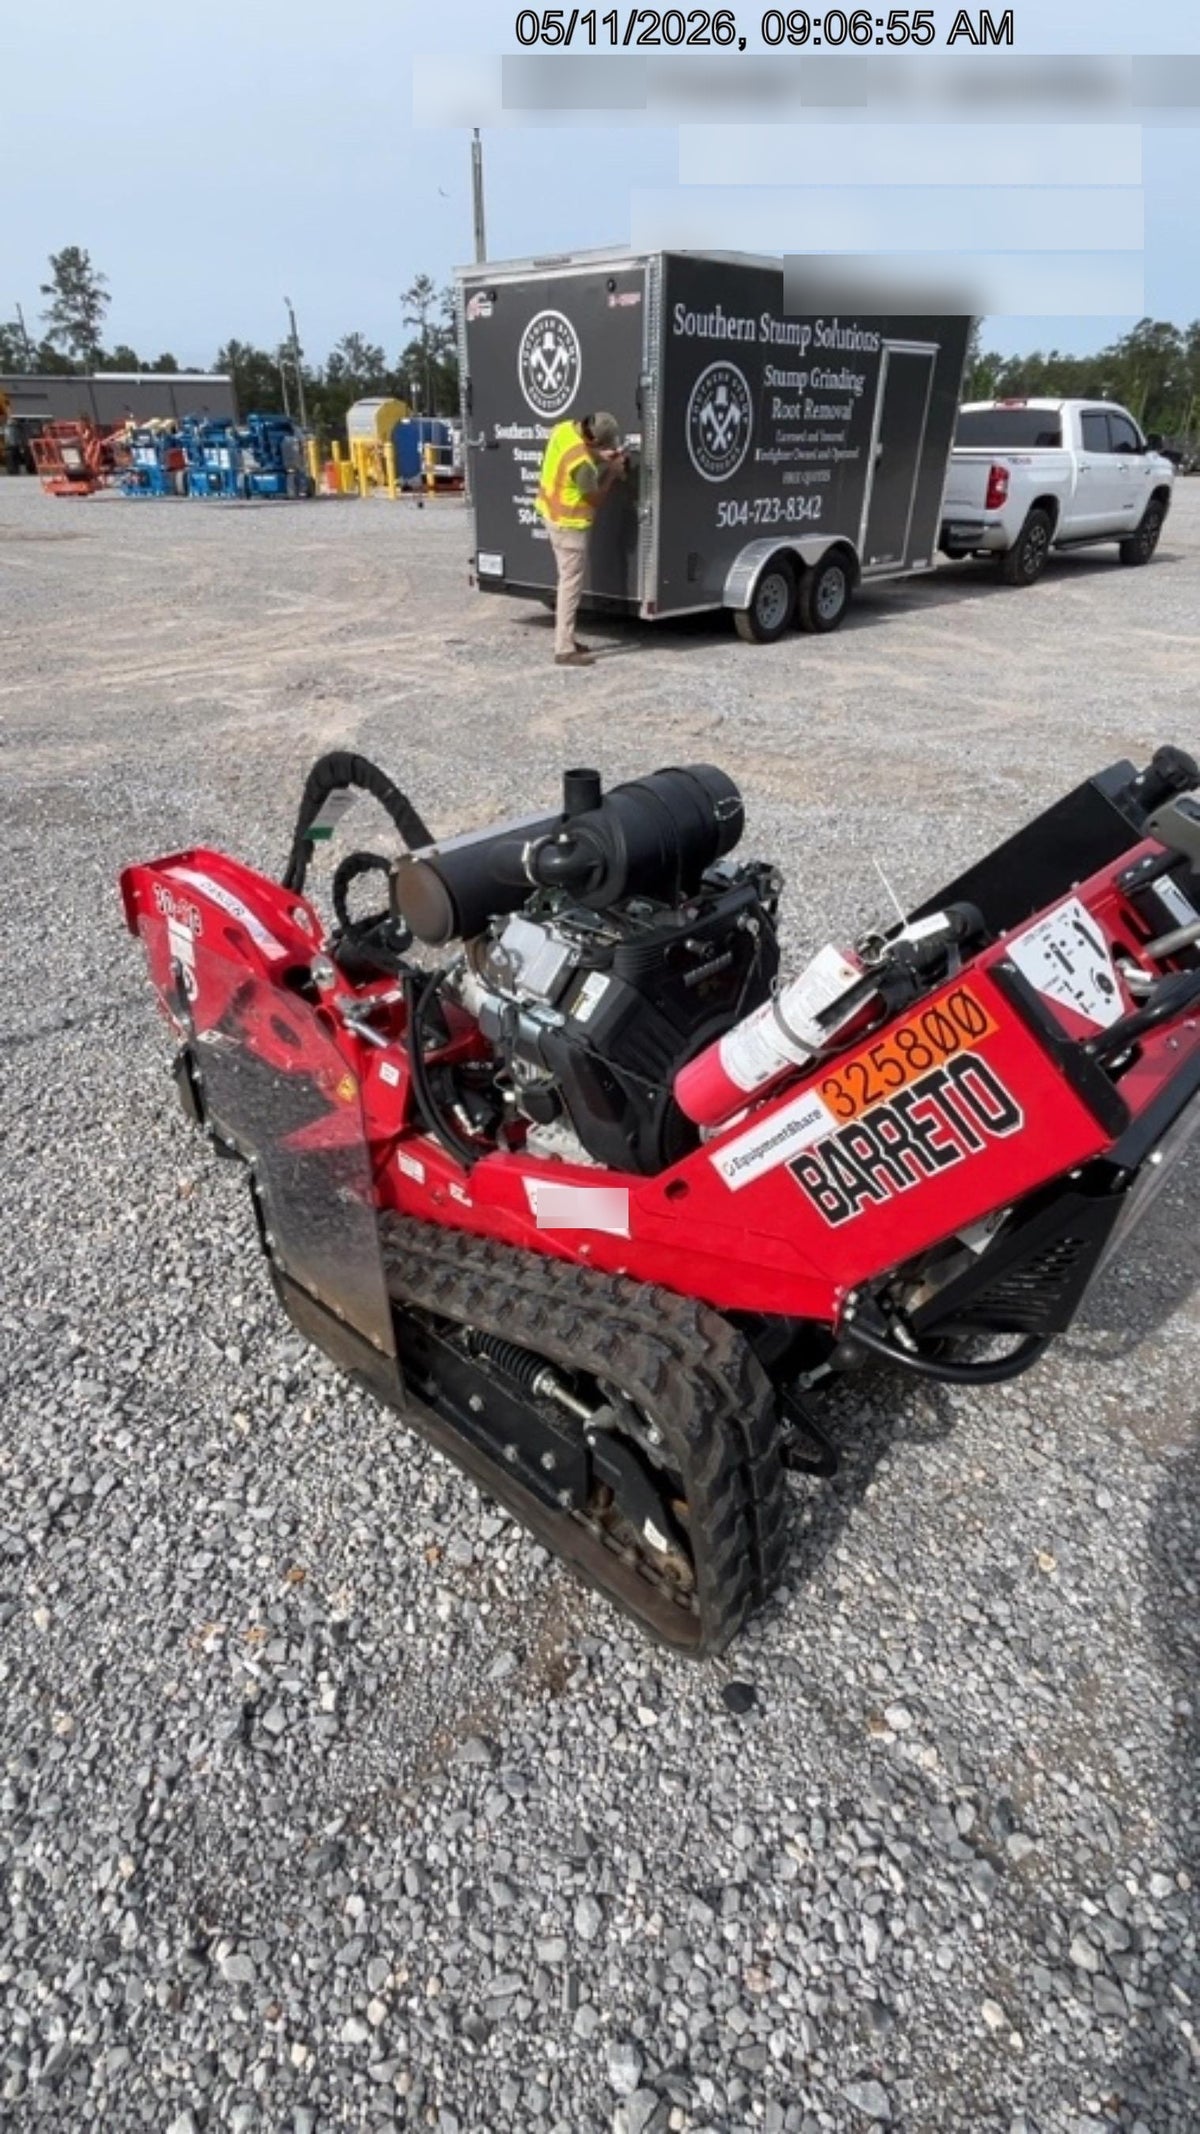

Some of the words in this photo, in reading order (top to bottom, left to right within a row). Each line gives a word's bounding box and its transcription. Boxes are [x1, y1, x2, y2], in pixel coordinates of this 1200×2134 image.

[673, 303, 755, 341] Southern
[759, 312, 811, 356] Stump
[813, 318, 880, 352] Solutions
[763, 364, 809, 395] Stump
[810, 367, 866, 397] Grinding
[772, 397, 801, 420] Root
[803, 398, 854, 421] Removal
[494, 422, 534, 440] Southern
[715, 495, 822, 528] 504-723-8342
[821, 988, 989, 1119] 325800
[732, 1108, 823, 1170] EquipmentShare
[785, 1050, 1024, 1228] BARRETO
